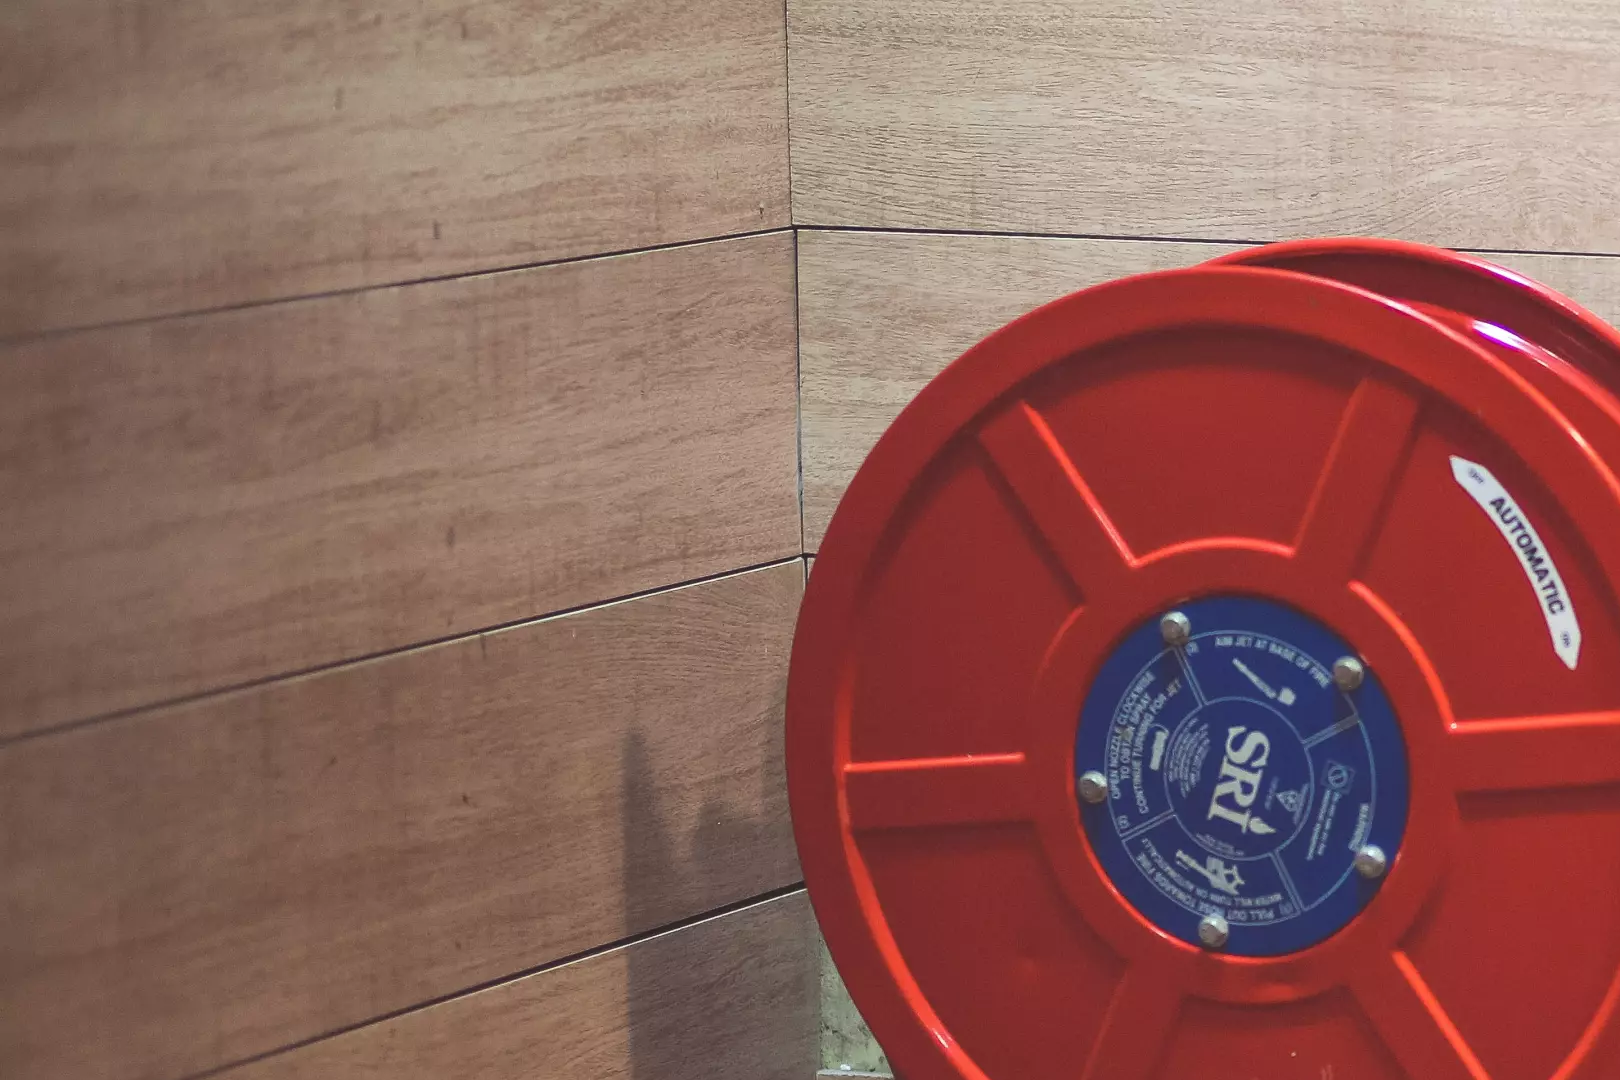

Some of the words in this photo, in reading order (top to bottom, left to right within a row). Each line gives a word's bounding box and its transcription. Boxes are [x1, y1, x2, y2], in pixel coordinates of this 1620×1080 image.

[1490, 497, 1566, 615] AUTOMATIC
[1118, 671, 1155, 724] CLOCKWISE
[1149, 693, 1167, 714] FOR
[1166, 678, 1182, 698] JET
[1110, 726, 1125, 768] NOZZLE
[1120, 766, 1130, 780] TO
[1129, 692, 1151, 725] SPRAY
[1132, 712, 1154, 757] TURNING
[1109, 770, 1121, 799] OPEN
[1132, 760, 1149, 814] CONTINUE
[1208, 727, 1271, 833] SRI
[1136, 853, 1156, 874] FIRE
[1154, 872, 1196, 908] TOWARDS
[1227, 910, 1247, 921] OUT
[1249, 909, 1274, 924] PULL
